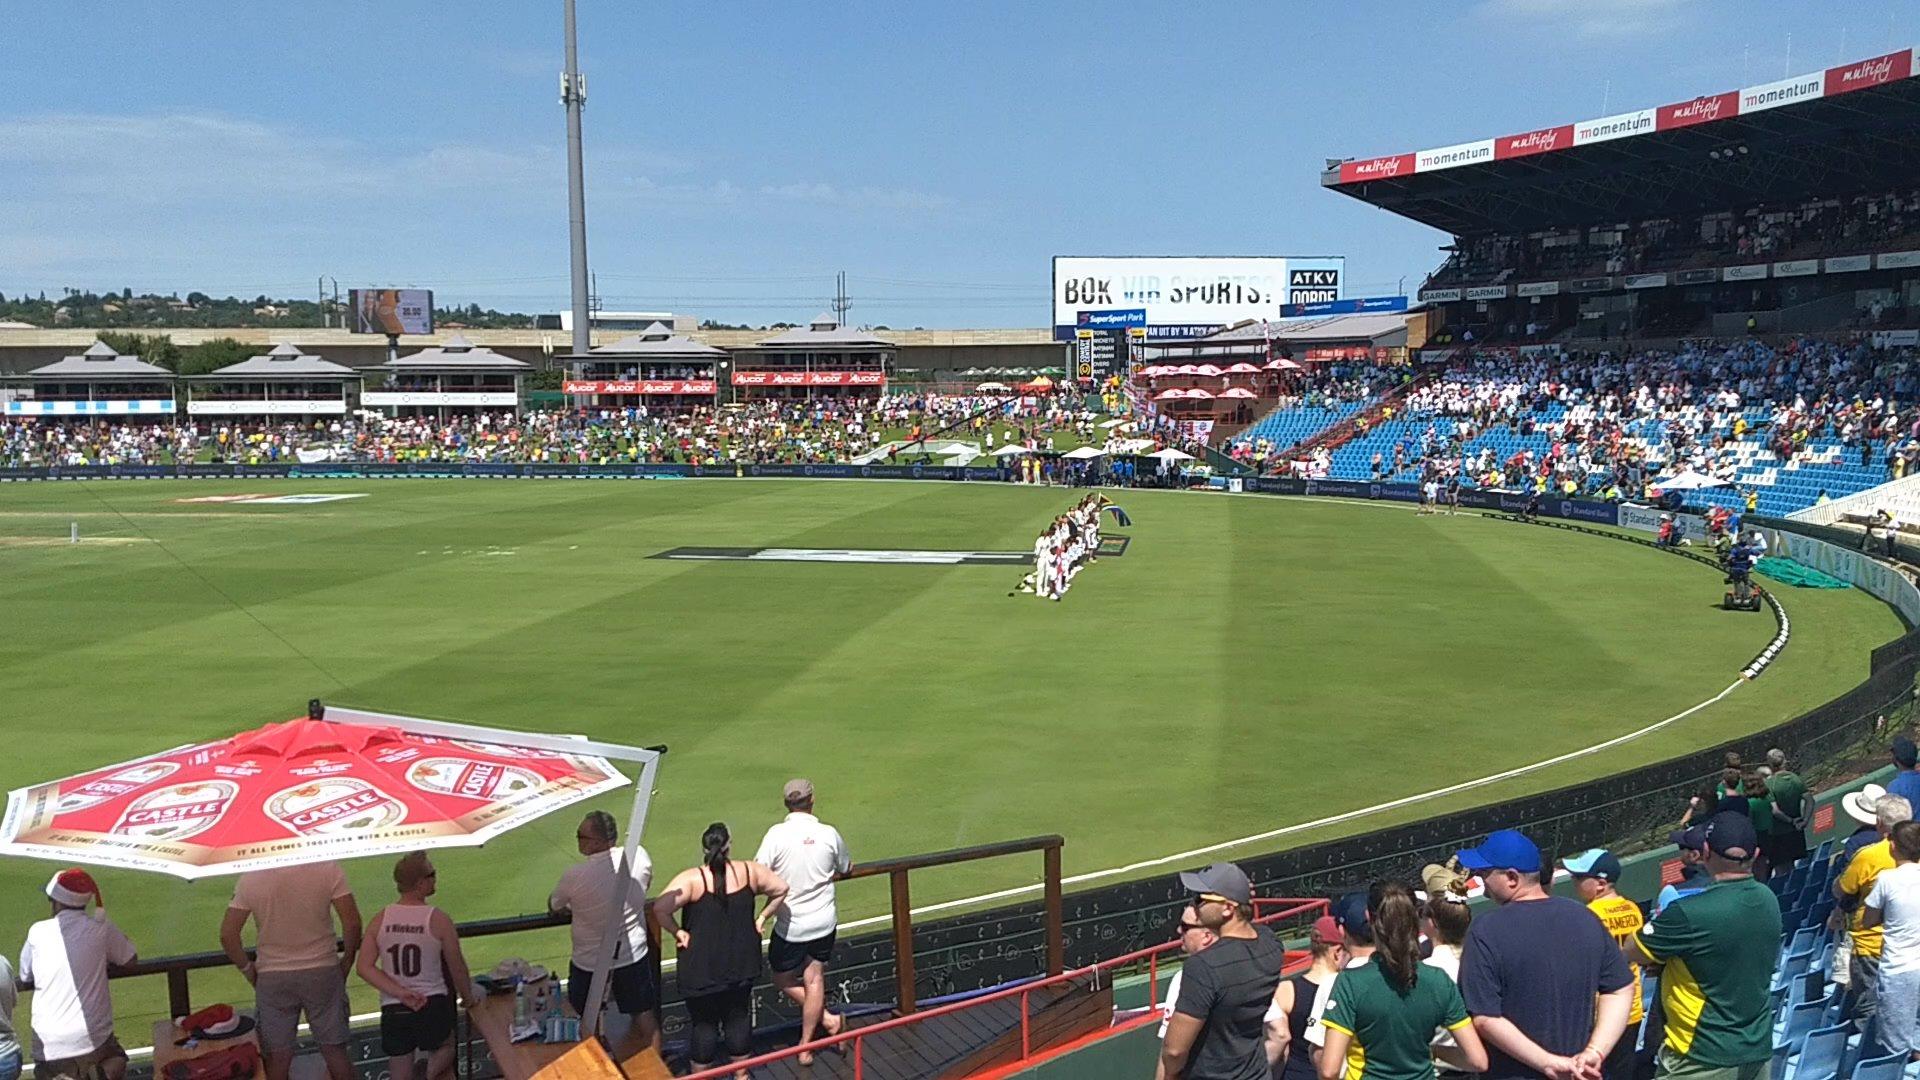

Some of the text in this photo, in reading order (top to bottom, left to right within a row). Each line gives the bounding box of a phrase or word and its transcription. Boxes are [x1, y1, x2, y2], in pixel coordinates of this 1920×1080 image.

[1842, 56, 1893, 83] multiply
[1744, 79, 1820, 107] momentum
[1672, 97, 1721, 122] multiply
[1580, 114, 1651, 139] momentum
[1510, 129, 1557, 150] multiply
[1421, 145, 1490, 167] momentum
[1355, 157, 1400, 177] multiply
[1293, 271, 1336, 284] ATKV
[1065, 277, 1112, 304] BOK
[1423, 291, 1459, 300] GARMIN
[1468, 288, 1504, 297] GARMIN
[1090, 312, 1143, 324] SuperSport Park
[1159, 326, 1170, 336] UIT
[1171, 326, 1180, 336] BY
[1573, 507, 1597, 517] Standard
[1629, 511, 1655, 525] Standard
[128, 802, 217, 823] CASTLE
[292, 791, 379, 825] CASTLE
[250, 847, 266, 855] ALL
[271, 842, 302, 852] COMES
[387, 943, 422, 978] 10
